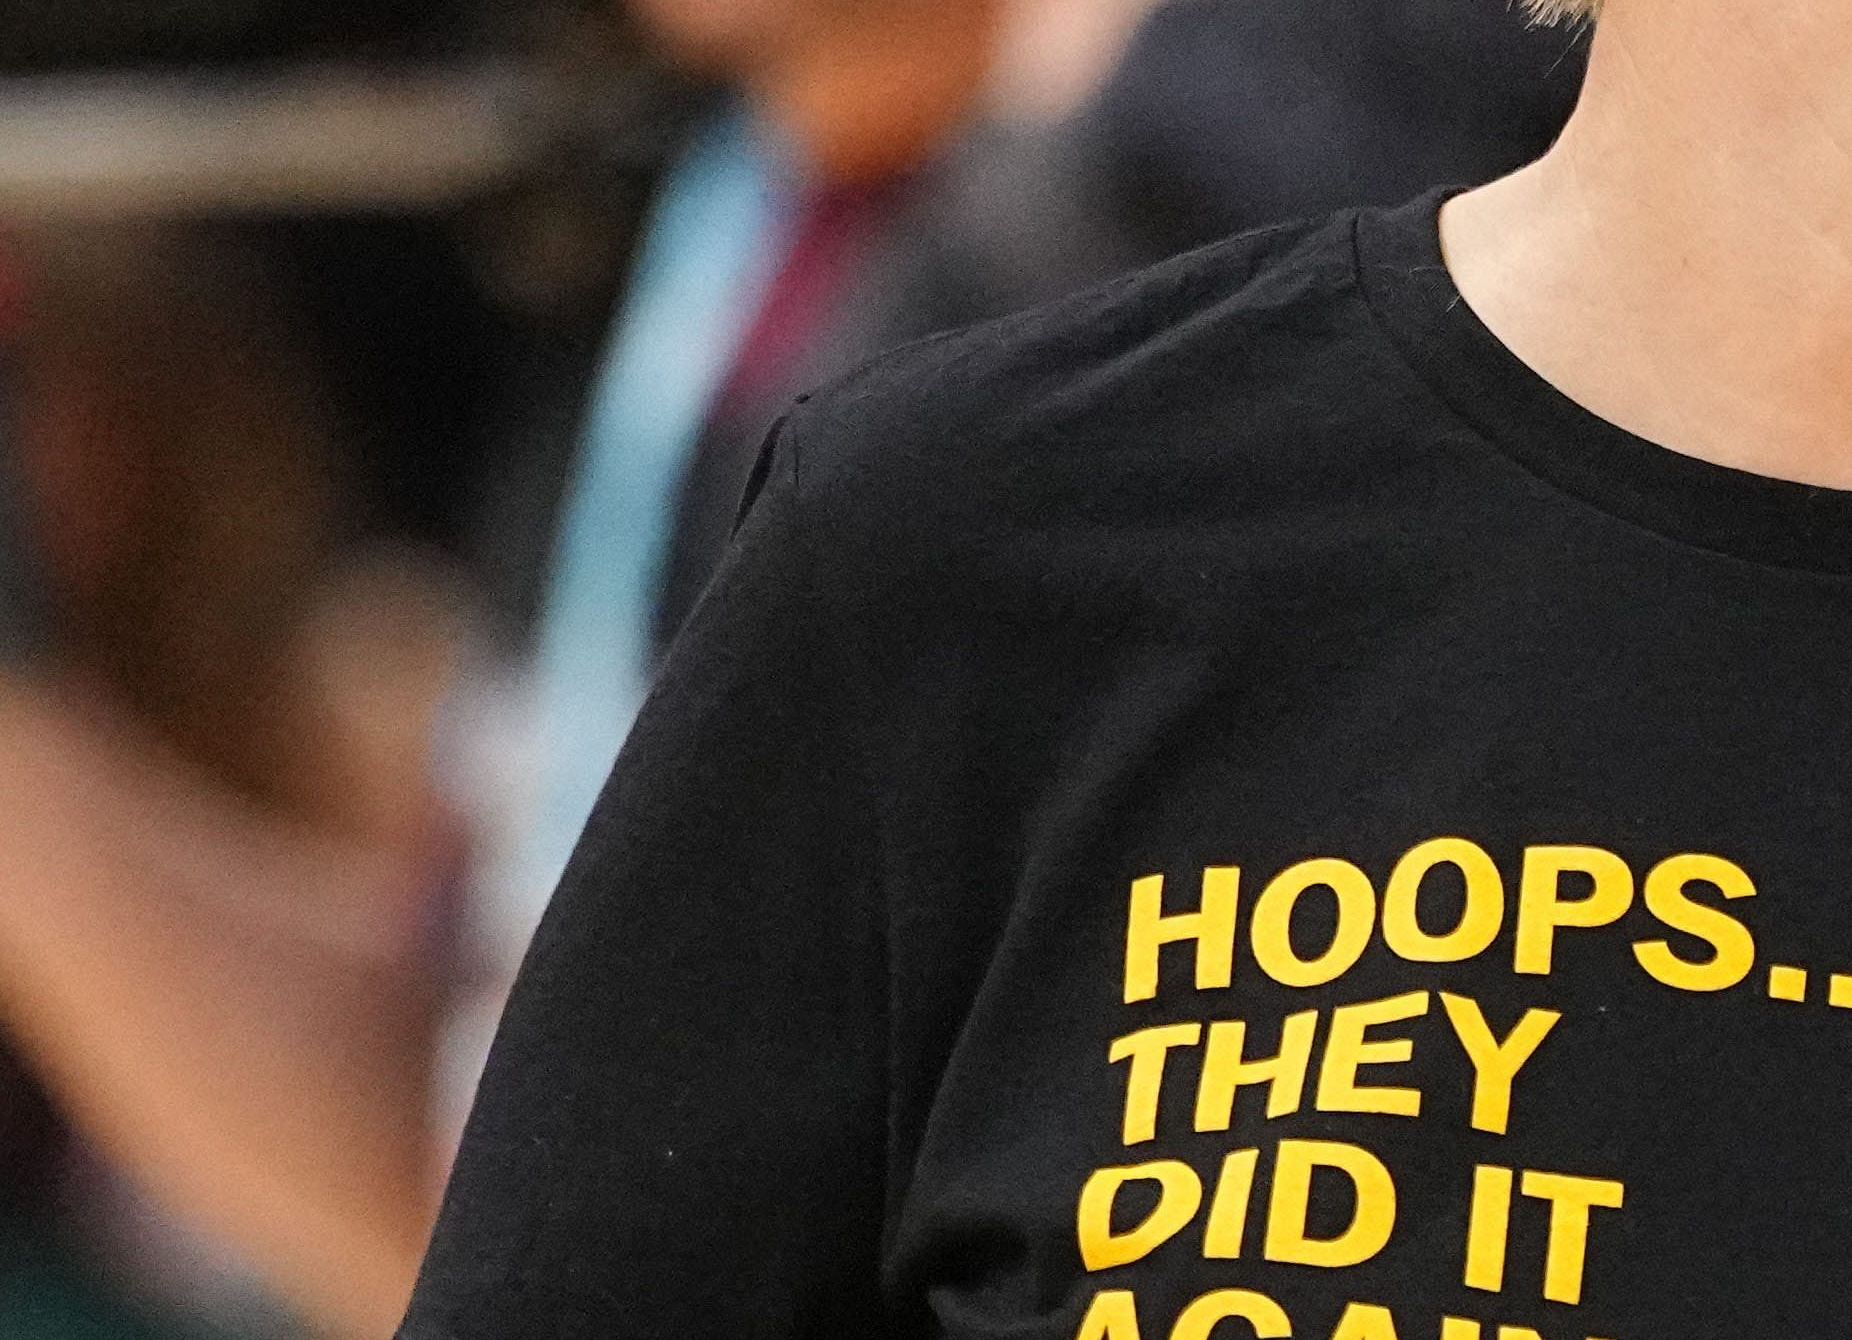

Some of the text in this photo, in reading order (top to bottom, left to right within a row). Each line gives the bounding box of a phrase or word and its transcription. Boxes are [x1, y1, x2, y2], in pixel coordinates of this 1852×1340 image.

[1106, 988, 1563, 1136] THEY
[1075, 1137, 1626, 1307] DID IT
